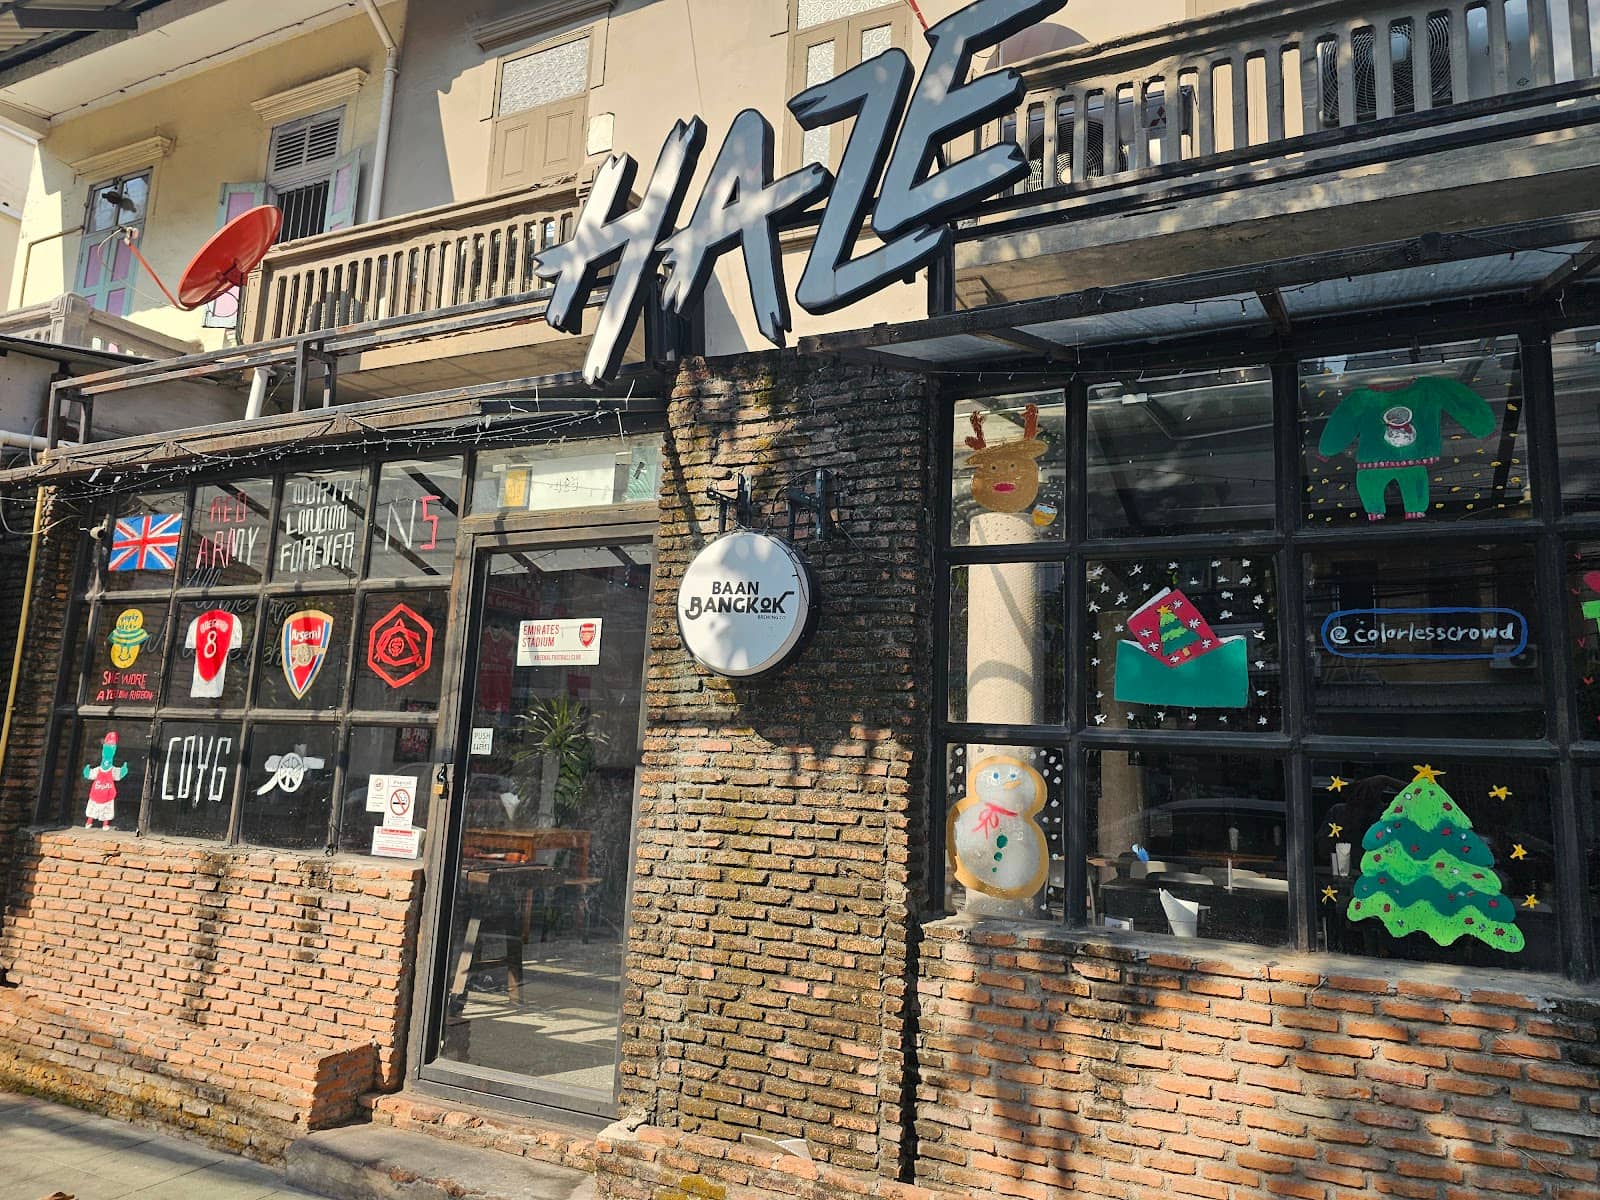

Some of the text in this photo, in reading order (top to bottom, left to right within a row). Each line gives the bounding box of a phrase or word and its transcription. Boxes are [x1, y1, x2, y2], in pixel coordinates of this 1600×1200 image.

[533, 0, 1067, 386] HAZE
[210, 491, 248, 524] RED
[285, 504, 348, 535] LONDON
[196, 526, 260, 569] ARMY
[279, 531, 355, 573] FOREVER
[711, 581, 760, 595] BAAN
[684, 591, 795, 620] BANGKOK
[203, 630, 217, 658] 8
[521, 637, 555, 648] STADIUM
[523, 624, 560, 636] EMIRATES
[1329, 622, 1515, 644] @colorlesscrowd
[102, 670, 148, 689] SHE WORE
[96, 690, 105, 702] A
[474, 731, 491, 739] PUSH
[161, 735, 232, 808] COYG
